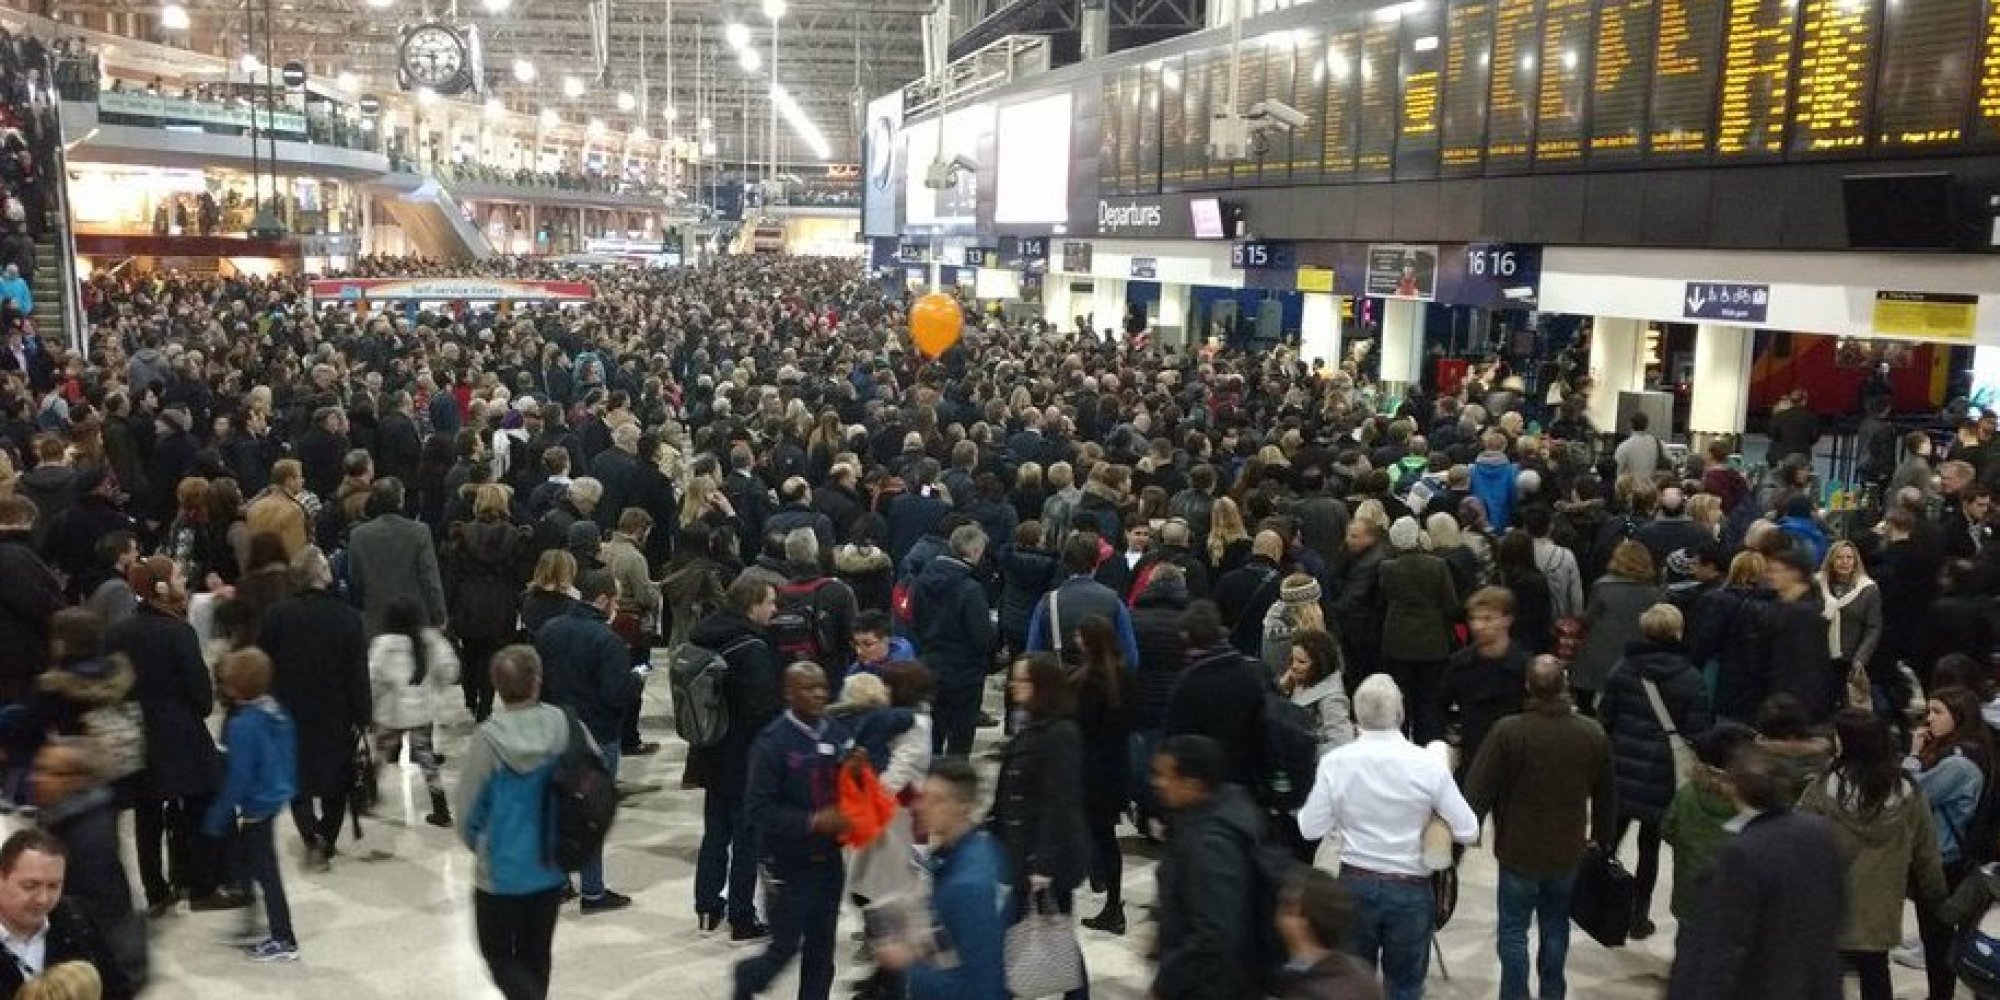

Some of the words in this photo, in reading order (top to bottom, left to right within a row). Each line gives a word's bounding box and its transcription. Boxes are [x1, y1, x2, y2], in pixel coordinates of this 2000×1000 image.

[1099, 199, 1161, 233] Departures
[969, 250, 982, 263] 13
[1025, 240, 1041, 255] 14
[1247, 246, 1268, 265] 15
[1468, 251, 1485, 275] 16
[1490, 251, 1516, 276] 16
